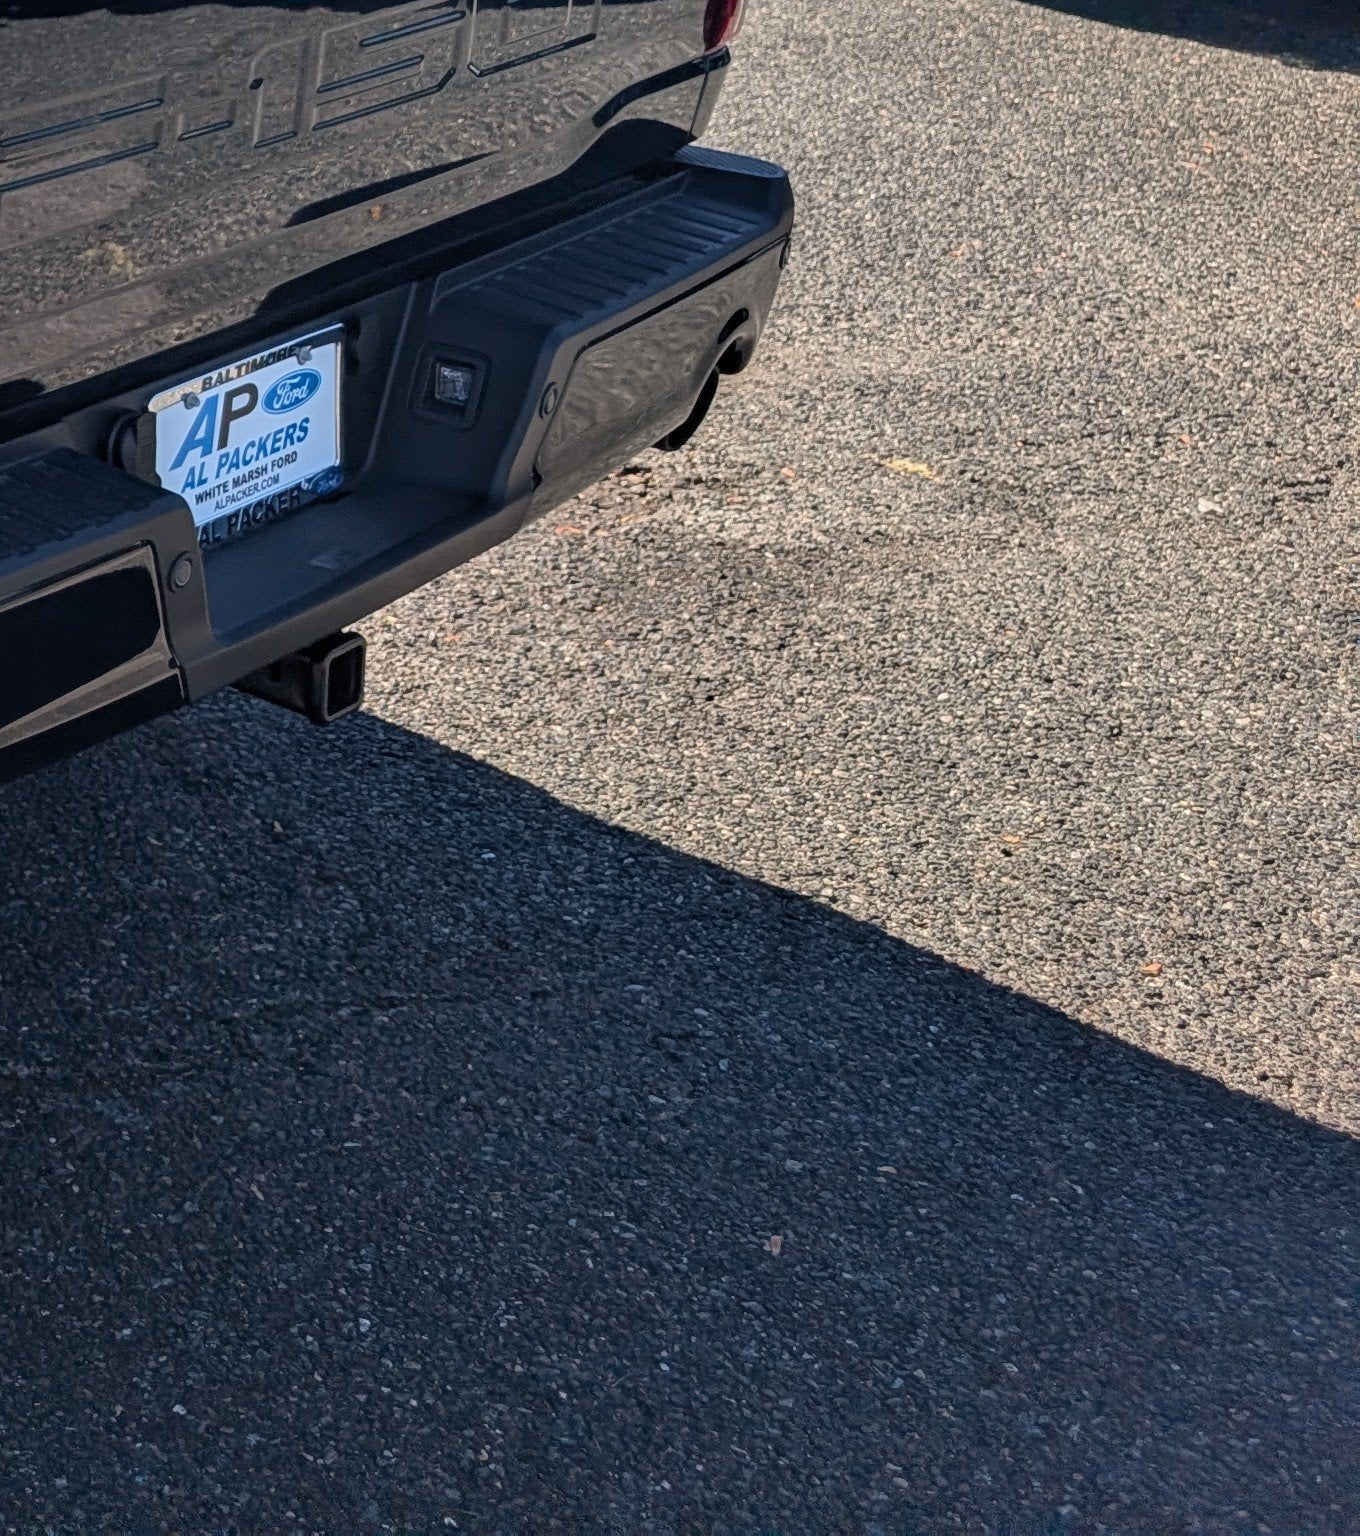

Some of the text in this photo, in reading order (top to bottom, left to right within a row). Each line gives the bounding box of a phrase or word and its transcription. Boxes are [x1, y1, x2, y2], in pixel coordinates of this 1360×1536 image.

[168, 375, 311, 472] AP Ford
[181, 416, 310, 494] AL PACKERS
[194, 450, 298, 505] WHITE MARSH FORD
[214, 472, 280, 512] ALPACKER.COM
